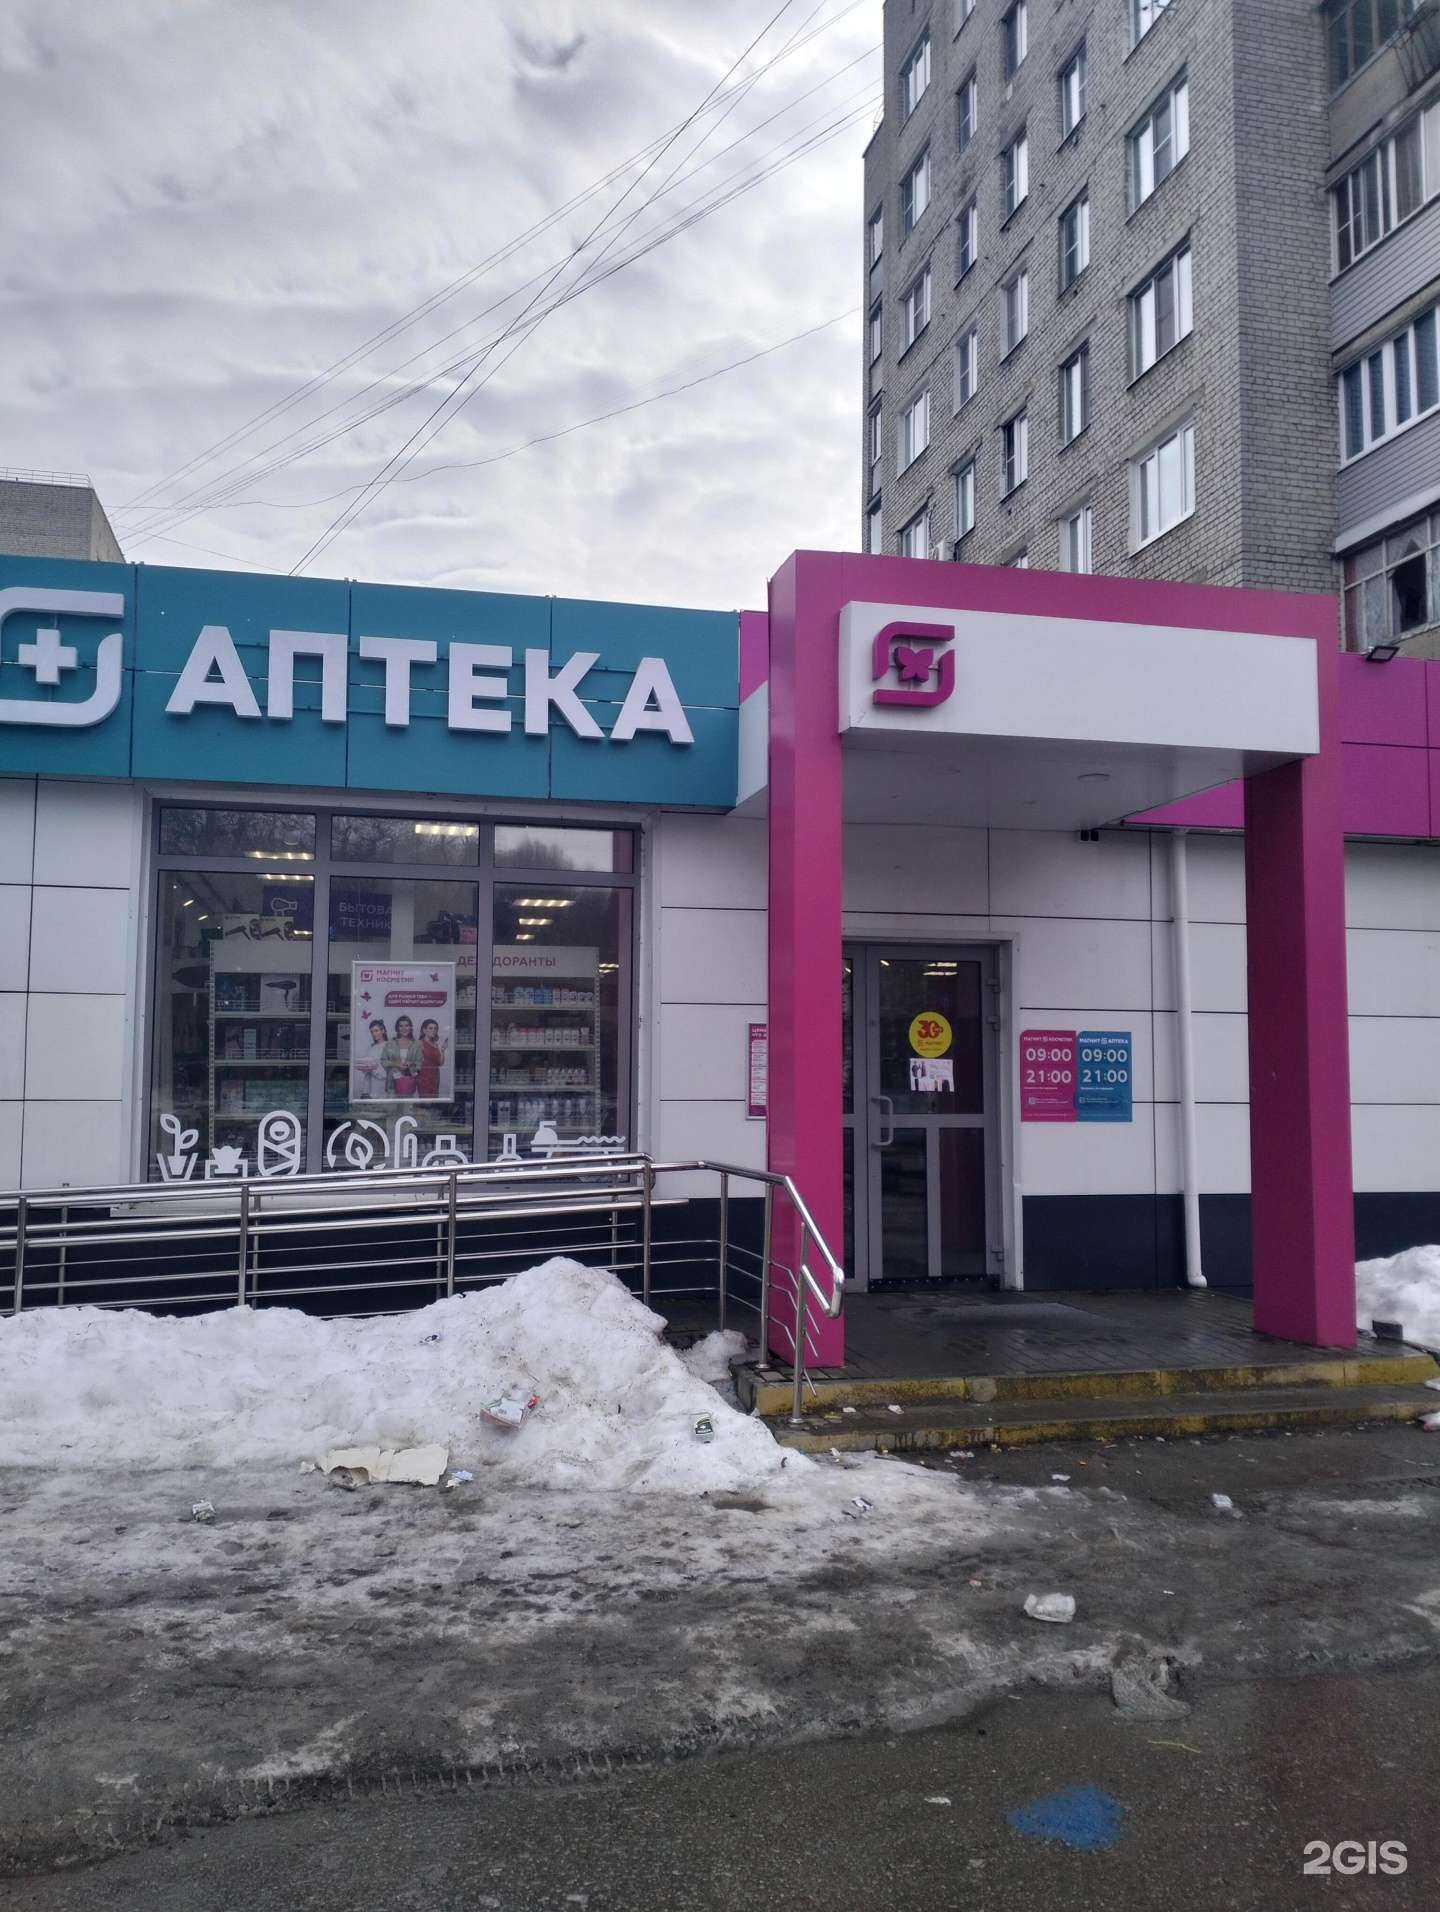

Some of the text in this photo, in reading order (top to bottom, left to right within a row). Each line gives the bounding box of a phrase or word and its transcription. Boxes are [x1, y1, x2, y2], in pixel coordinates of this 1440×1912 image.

[165, 625, 695, 745] АПТЕКА
[339, 902, 391, 914] БЫТОВА
[340, 917, 391, 928] ТЕХНИК
[457, 956, 556, 967] ДЕДОРАНТЫ
[1025, 1048, 1072, 1062] 09:00
[1081, 1048, 1128, 1062] 09:00
[1025, 1070, 1072, 1084] 21:00
[1082, 1070, 1128, 1084] 21:00
